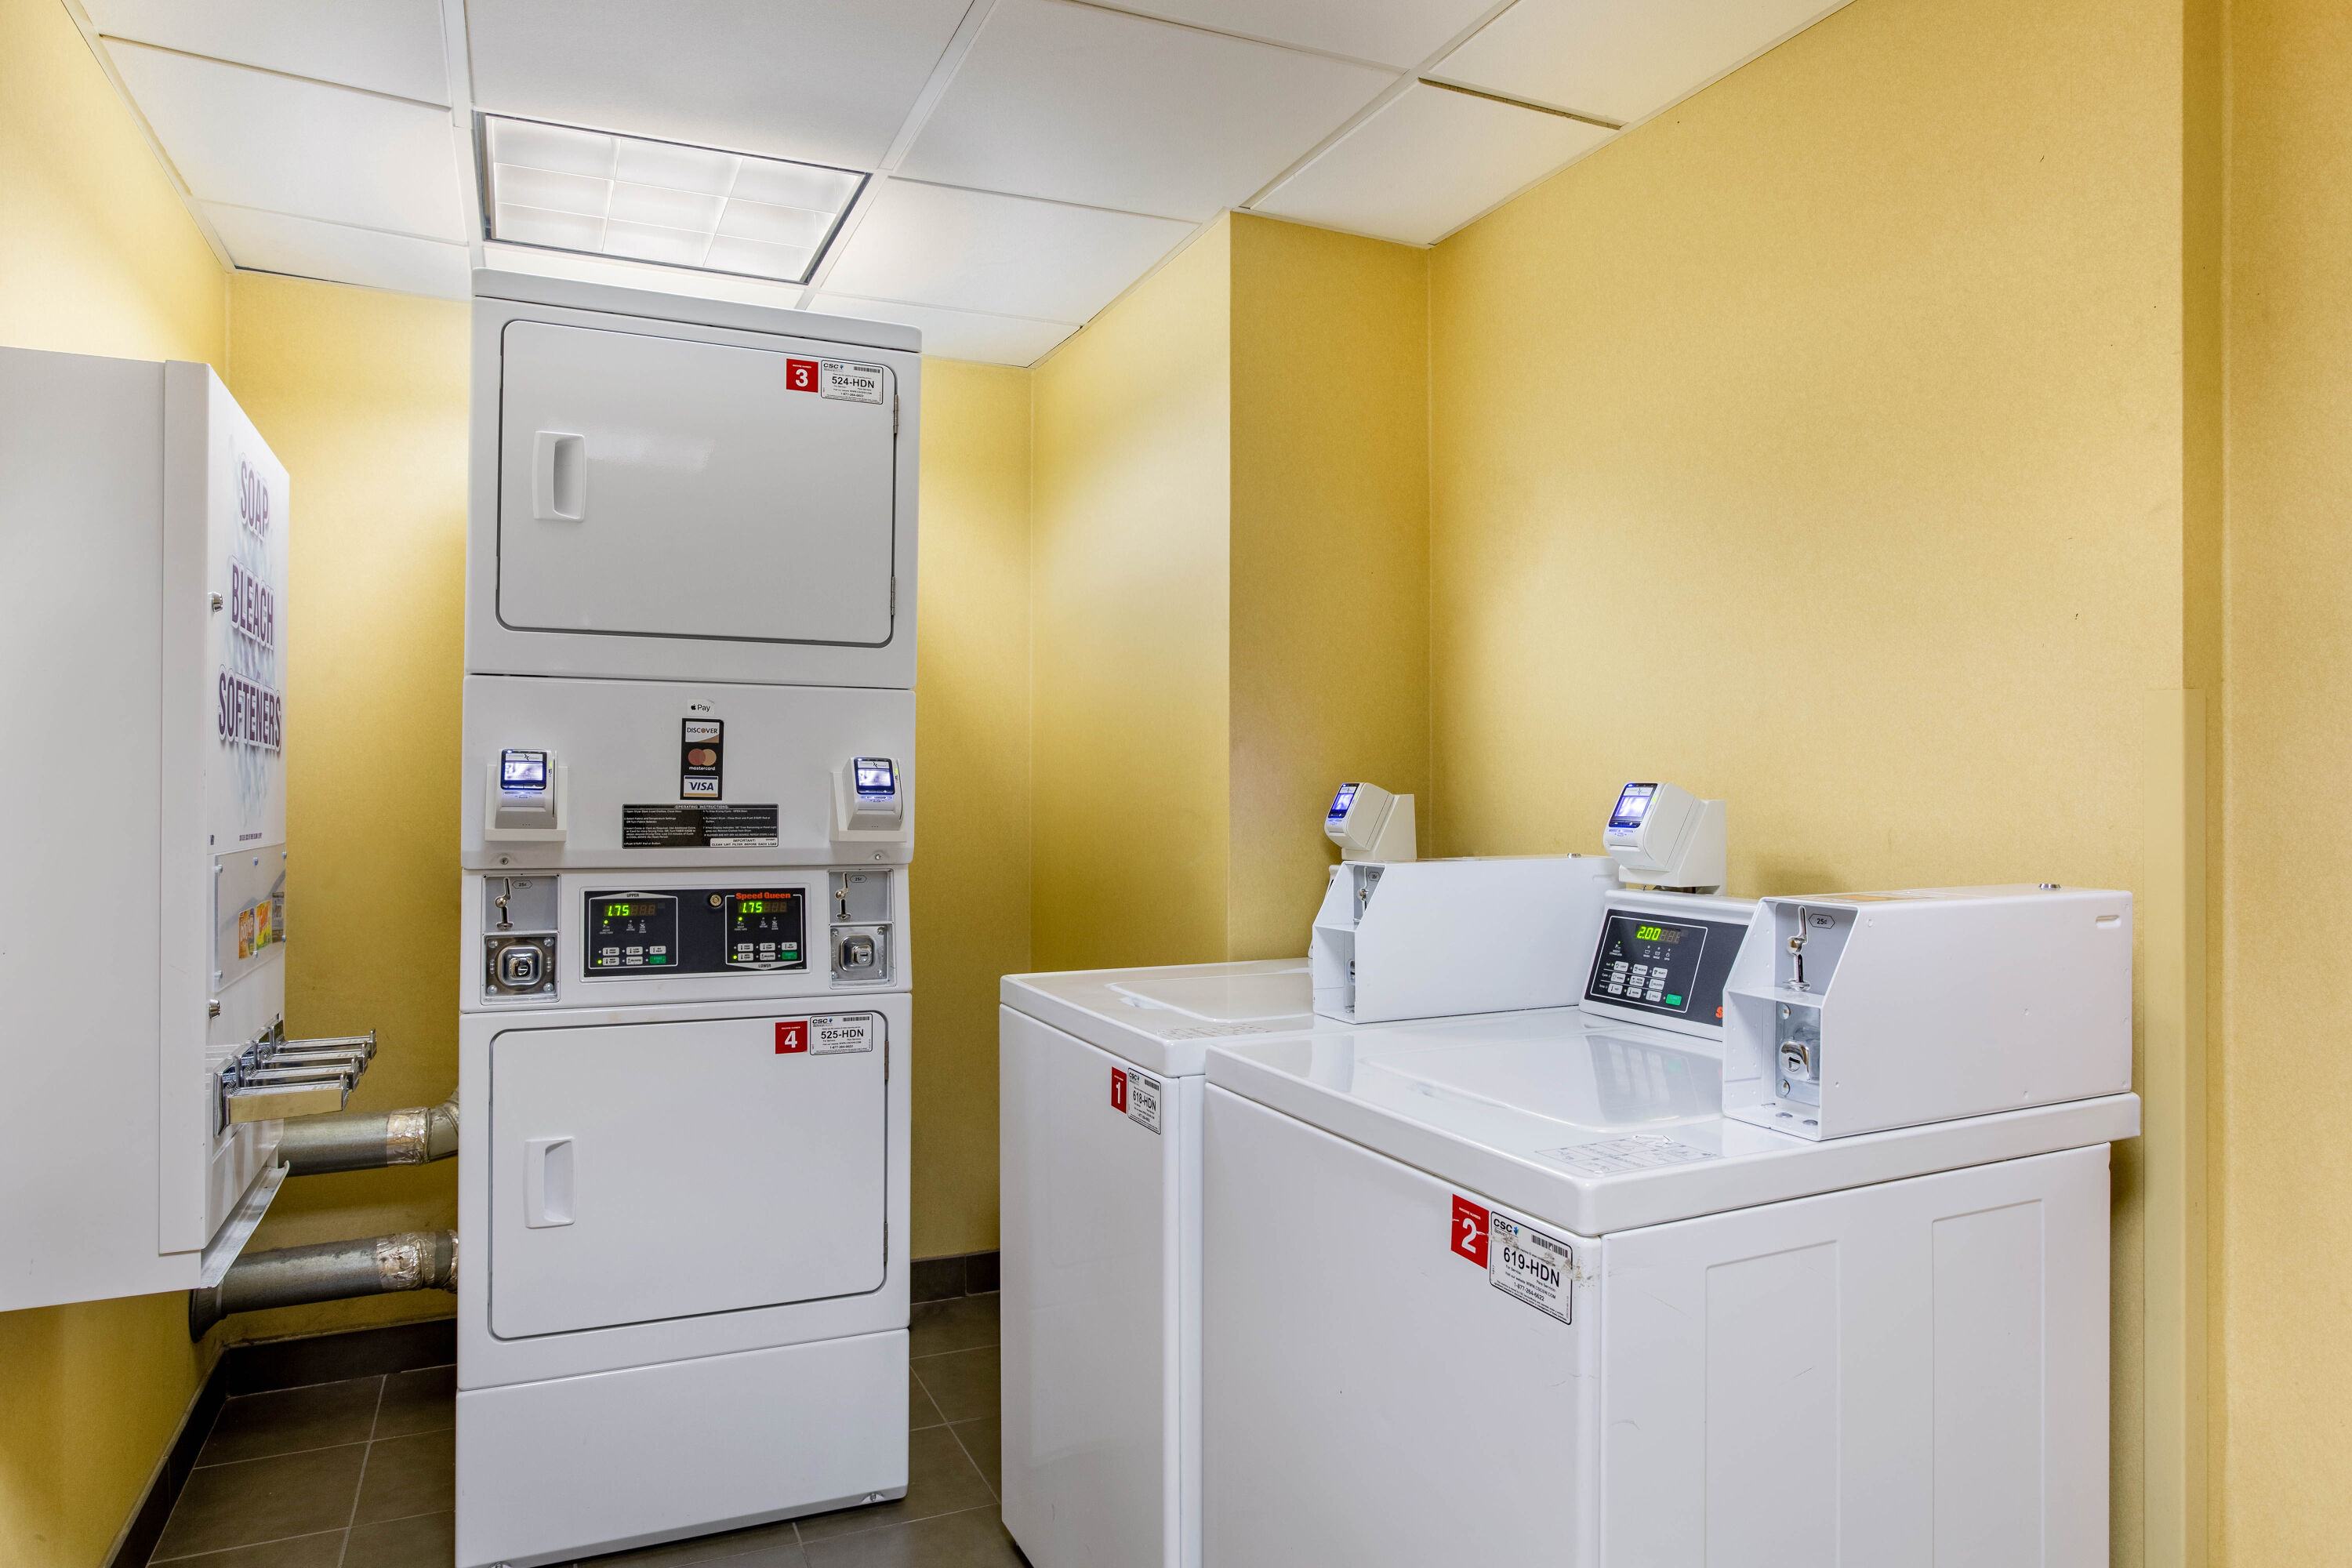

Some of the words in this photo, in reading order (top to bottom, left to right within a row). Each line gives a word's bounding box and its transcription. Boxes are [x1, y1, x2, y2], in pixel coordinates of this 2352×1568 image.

[795, 368, 808, 387] 3
[832, 376, 874, 389] 524-HDN
[240, 460, 269, 538] SOAP
[231, 564, 274, 646] BLEACH
[218, 671, 281, 749] SOFTENERS
[697, 704, 710, 713] Pay
[688, 782, 714, 791] VISA
[608, 905, 630, 916] 1.75
[742, 902, 763, 913] 1.75
[1636, 926, 1661, 941] 2.00
[784, 1030, 798, 1048] 4
[821, 1029, 864, 1040] 525-HDN
[1116, 1082, 1121, 1104] 1
[1132, 1090, 1156, 1112] 618-HDN
[1494, 1218, 1513, 1233] CSC
[1461, 1218, 1477, 1254] 2
[1504, 1247, 1560, 1288] 619-HDN
